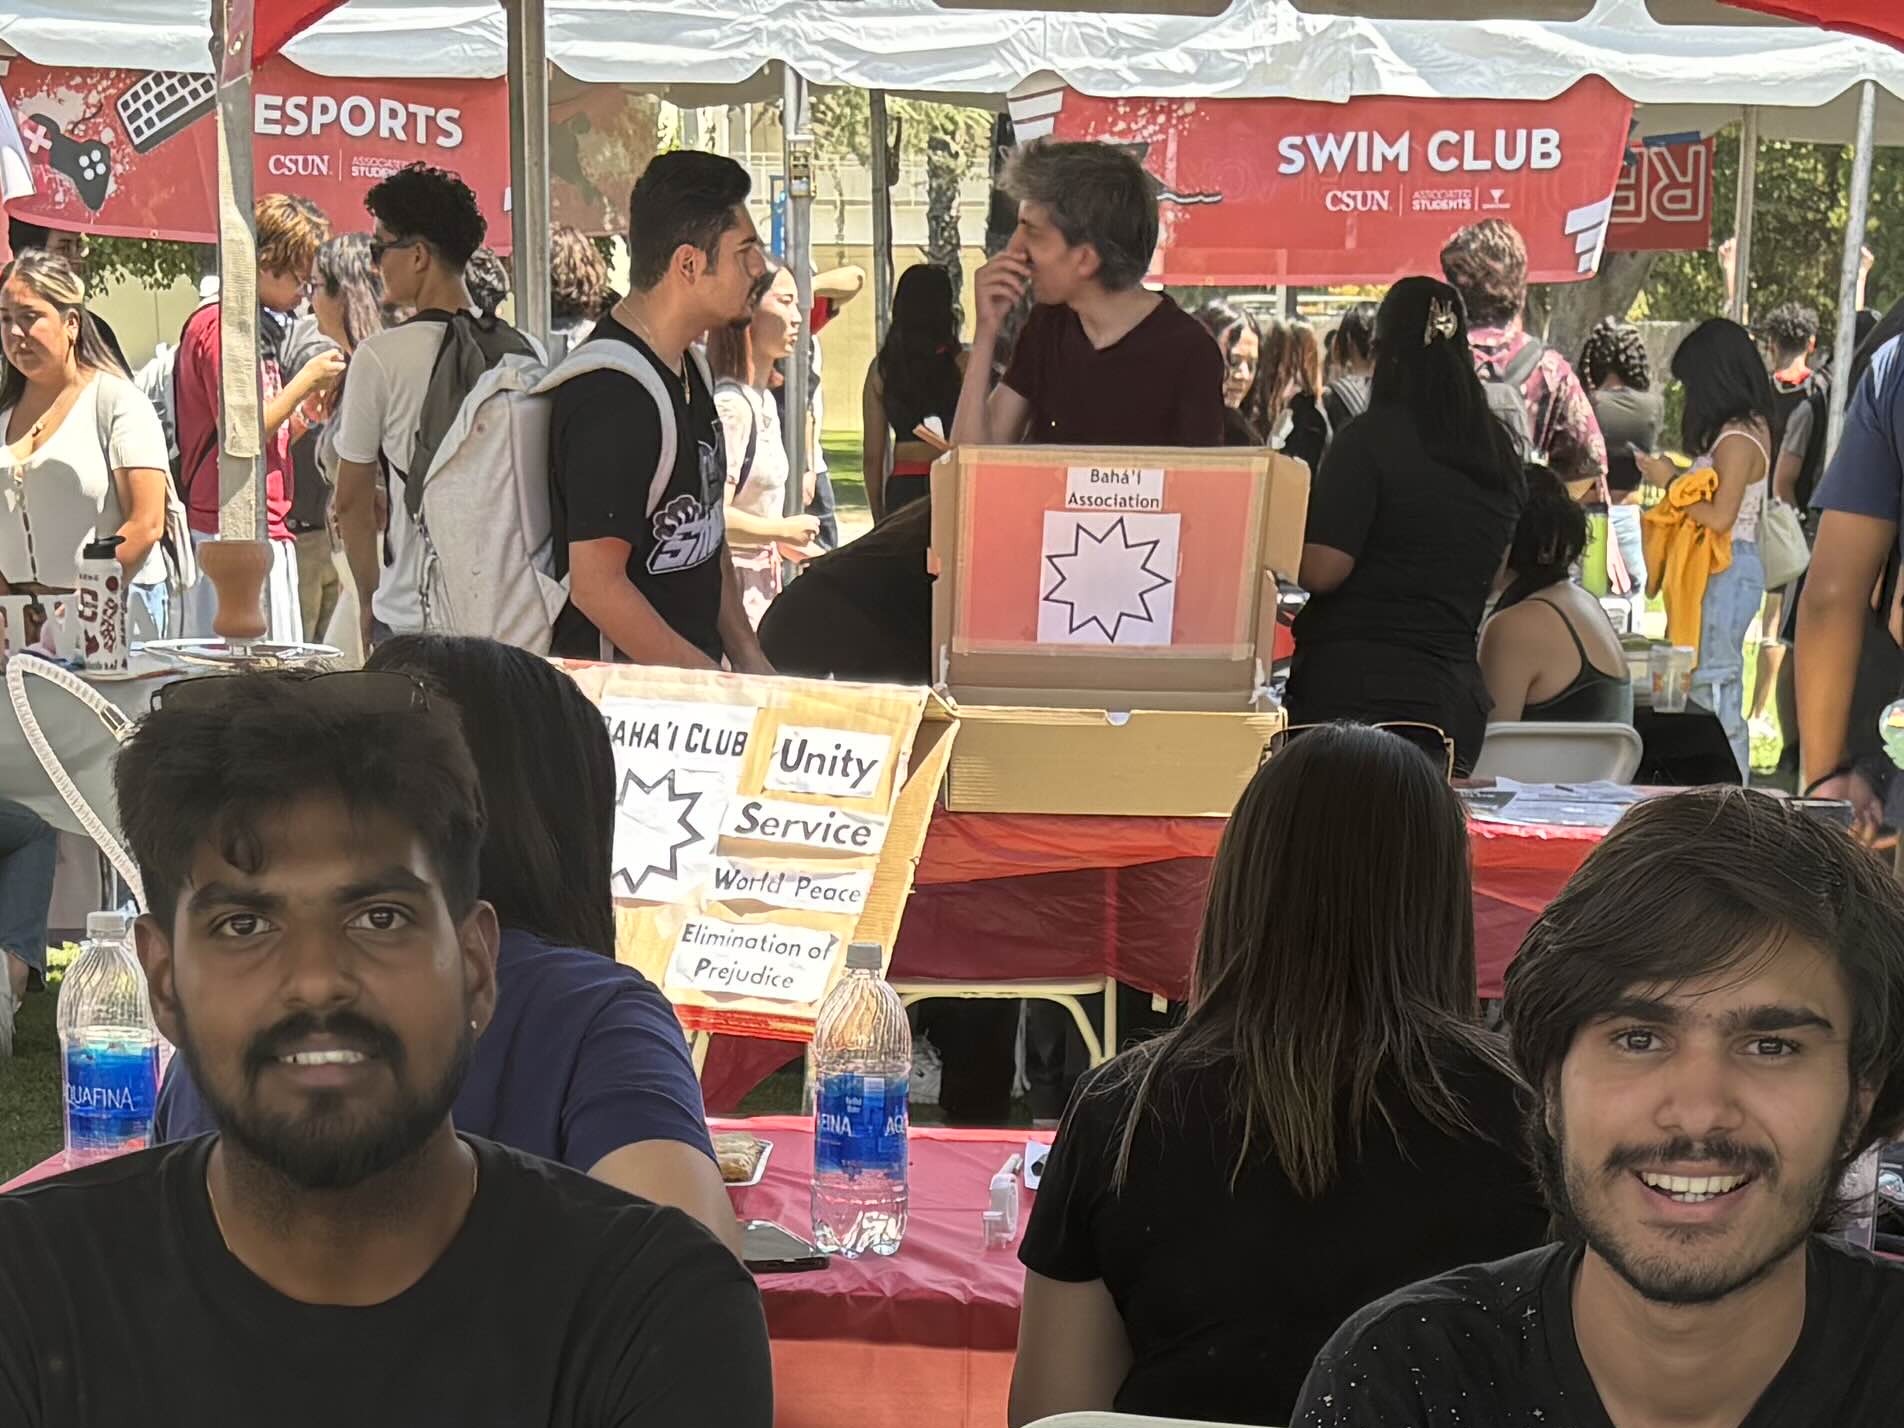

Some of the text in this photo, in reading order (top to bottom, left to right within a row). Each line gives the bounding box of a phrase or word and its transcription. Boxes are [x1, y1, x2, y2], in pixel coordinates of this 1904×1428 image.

[253, 94, 464, 148] ESPORTS
[267, 153, 330, 177] CSUN
[1276, 127, 1563, 175] SWIM CLUB
[1325, 190, 1390, 212] CSUN
[1412, 199, 1473, 212] STUDENTS
[1067, 491, 1160, 509] Association
[685, 723, 748, 757] CLUB
[779, 736, 879, 790] Unity
[733, 801, 872, 847] Service
[713, 866, 861, 903] World Peace
[680, 922, 802, 958] Elimination
[693, 957, 794, 990] Prejudice
[67, 1082, 136, 1112] QUAFINA
